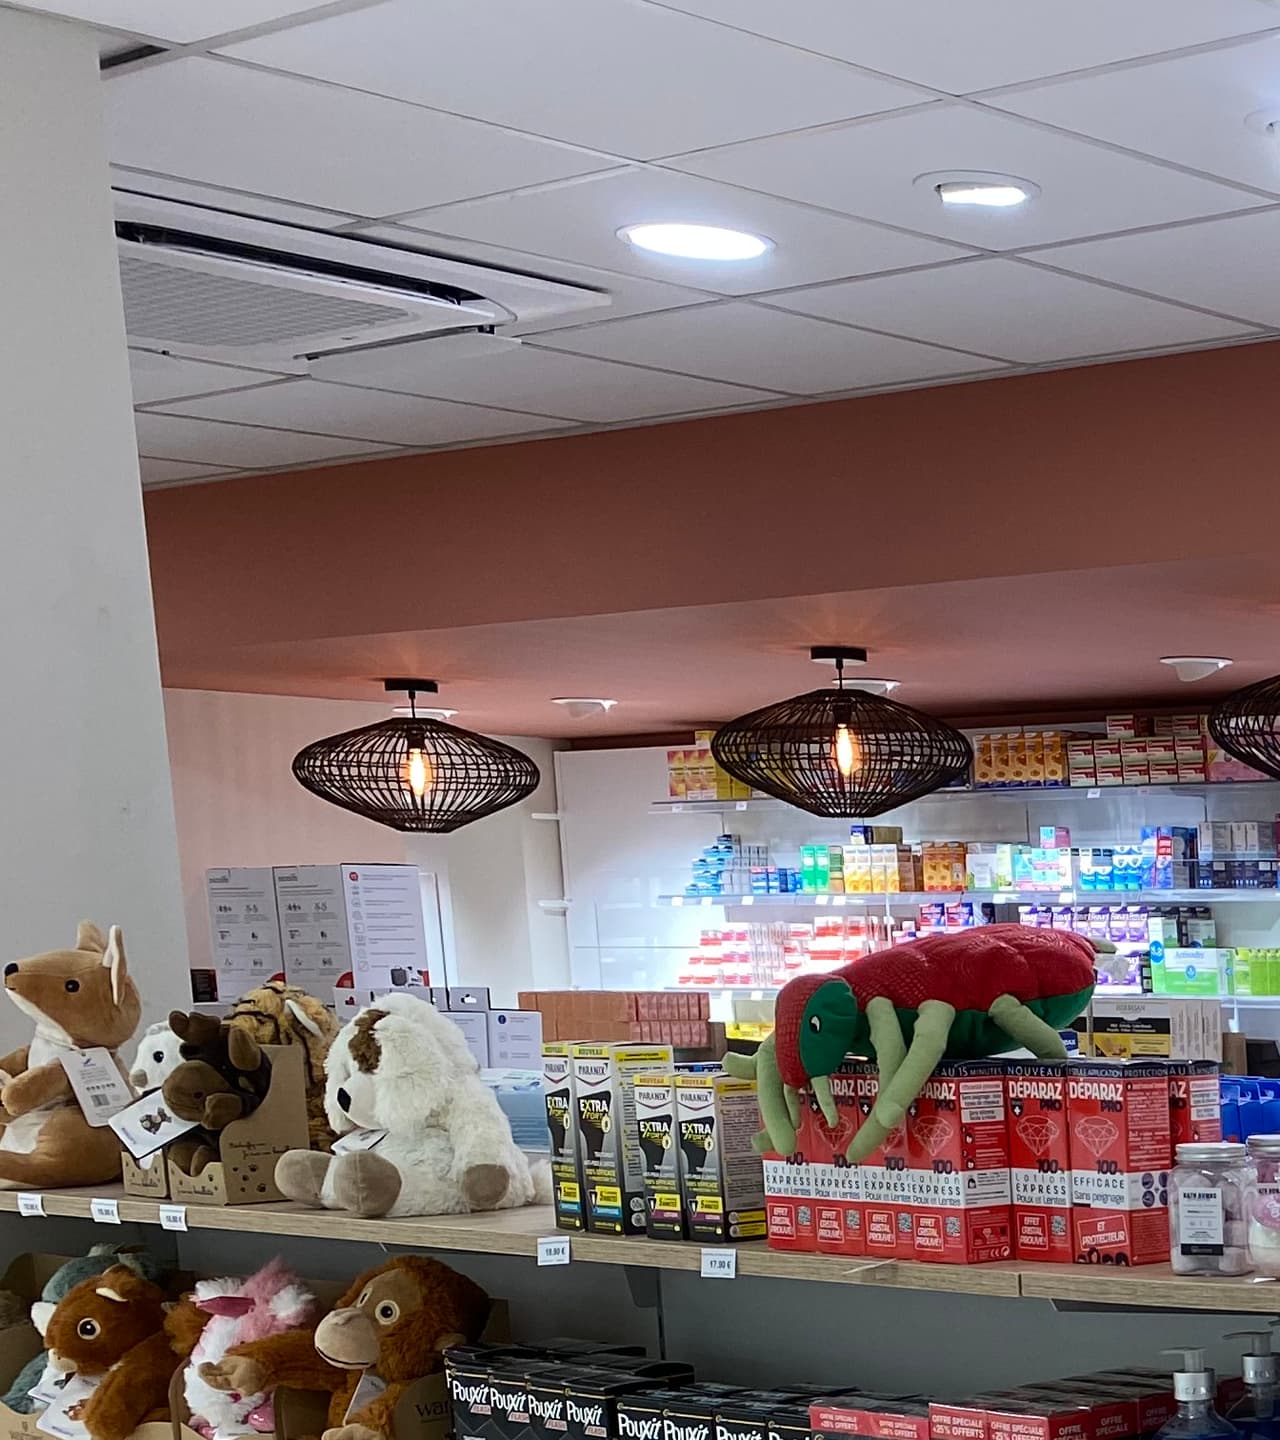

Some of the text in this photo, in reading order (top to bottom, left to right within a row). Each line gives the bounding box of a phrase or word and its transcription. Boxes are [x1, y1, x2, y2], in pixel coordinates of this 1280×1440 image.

[1007, 1066, 1062, 1077] NOUVEAU
[1009, 1077, 1063, 1100] DÉPARAZ
[1069, 1078, 1123, 1101] DÉPARAZ
[1016, 1183, 1066, 1195] EXPRESS
[1073, 1176, 1125, 1189] EFFICACE
[453, 1381, 489, 1408] Pouxit
[490, 1388, 527, 1416] Pouxit
[528, 1395, 564, 1423] Pouxit
[566, 1401, 602, 1428] Pouxit
